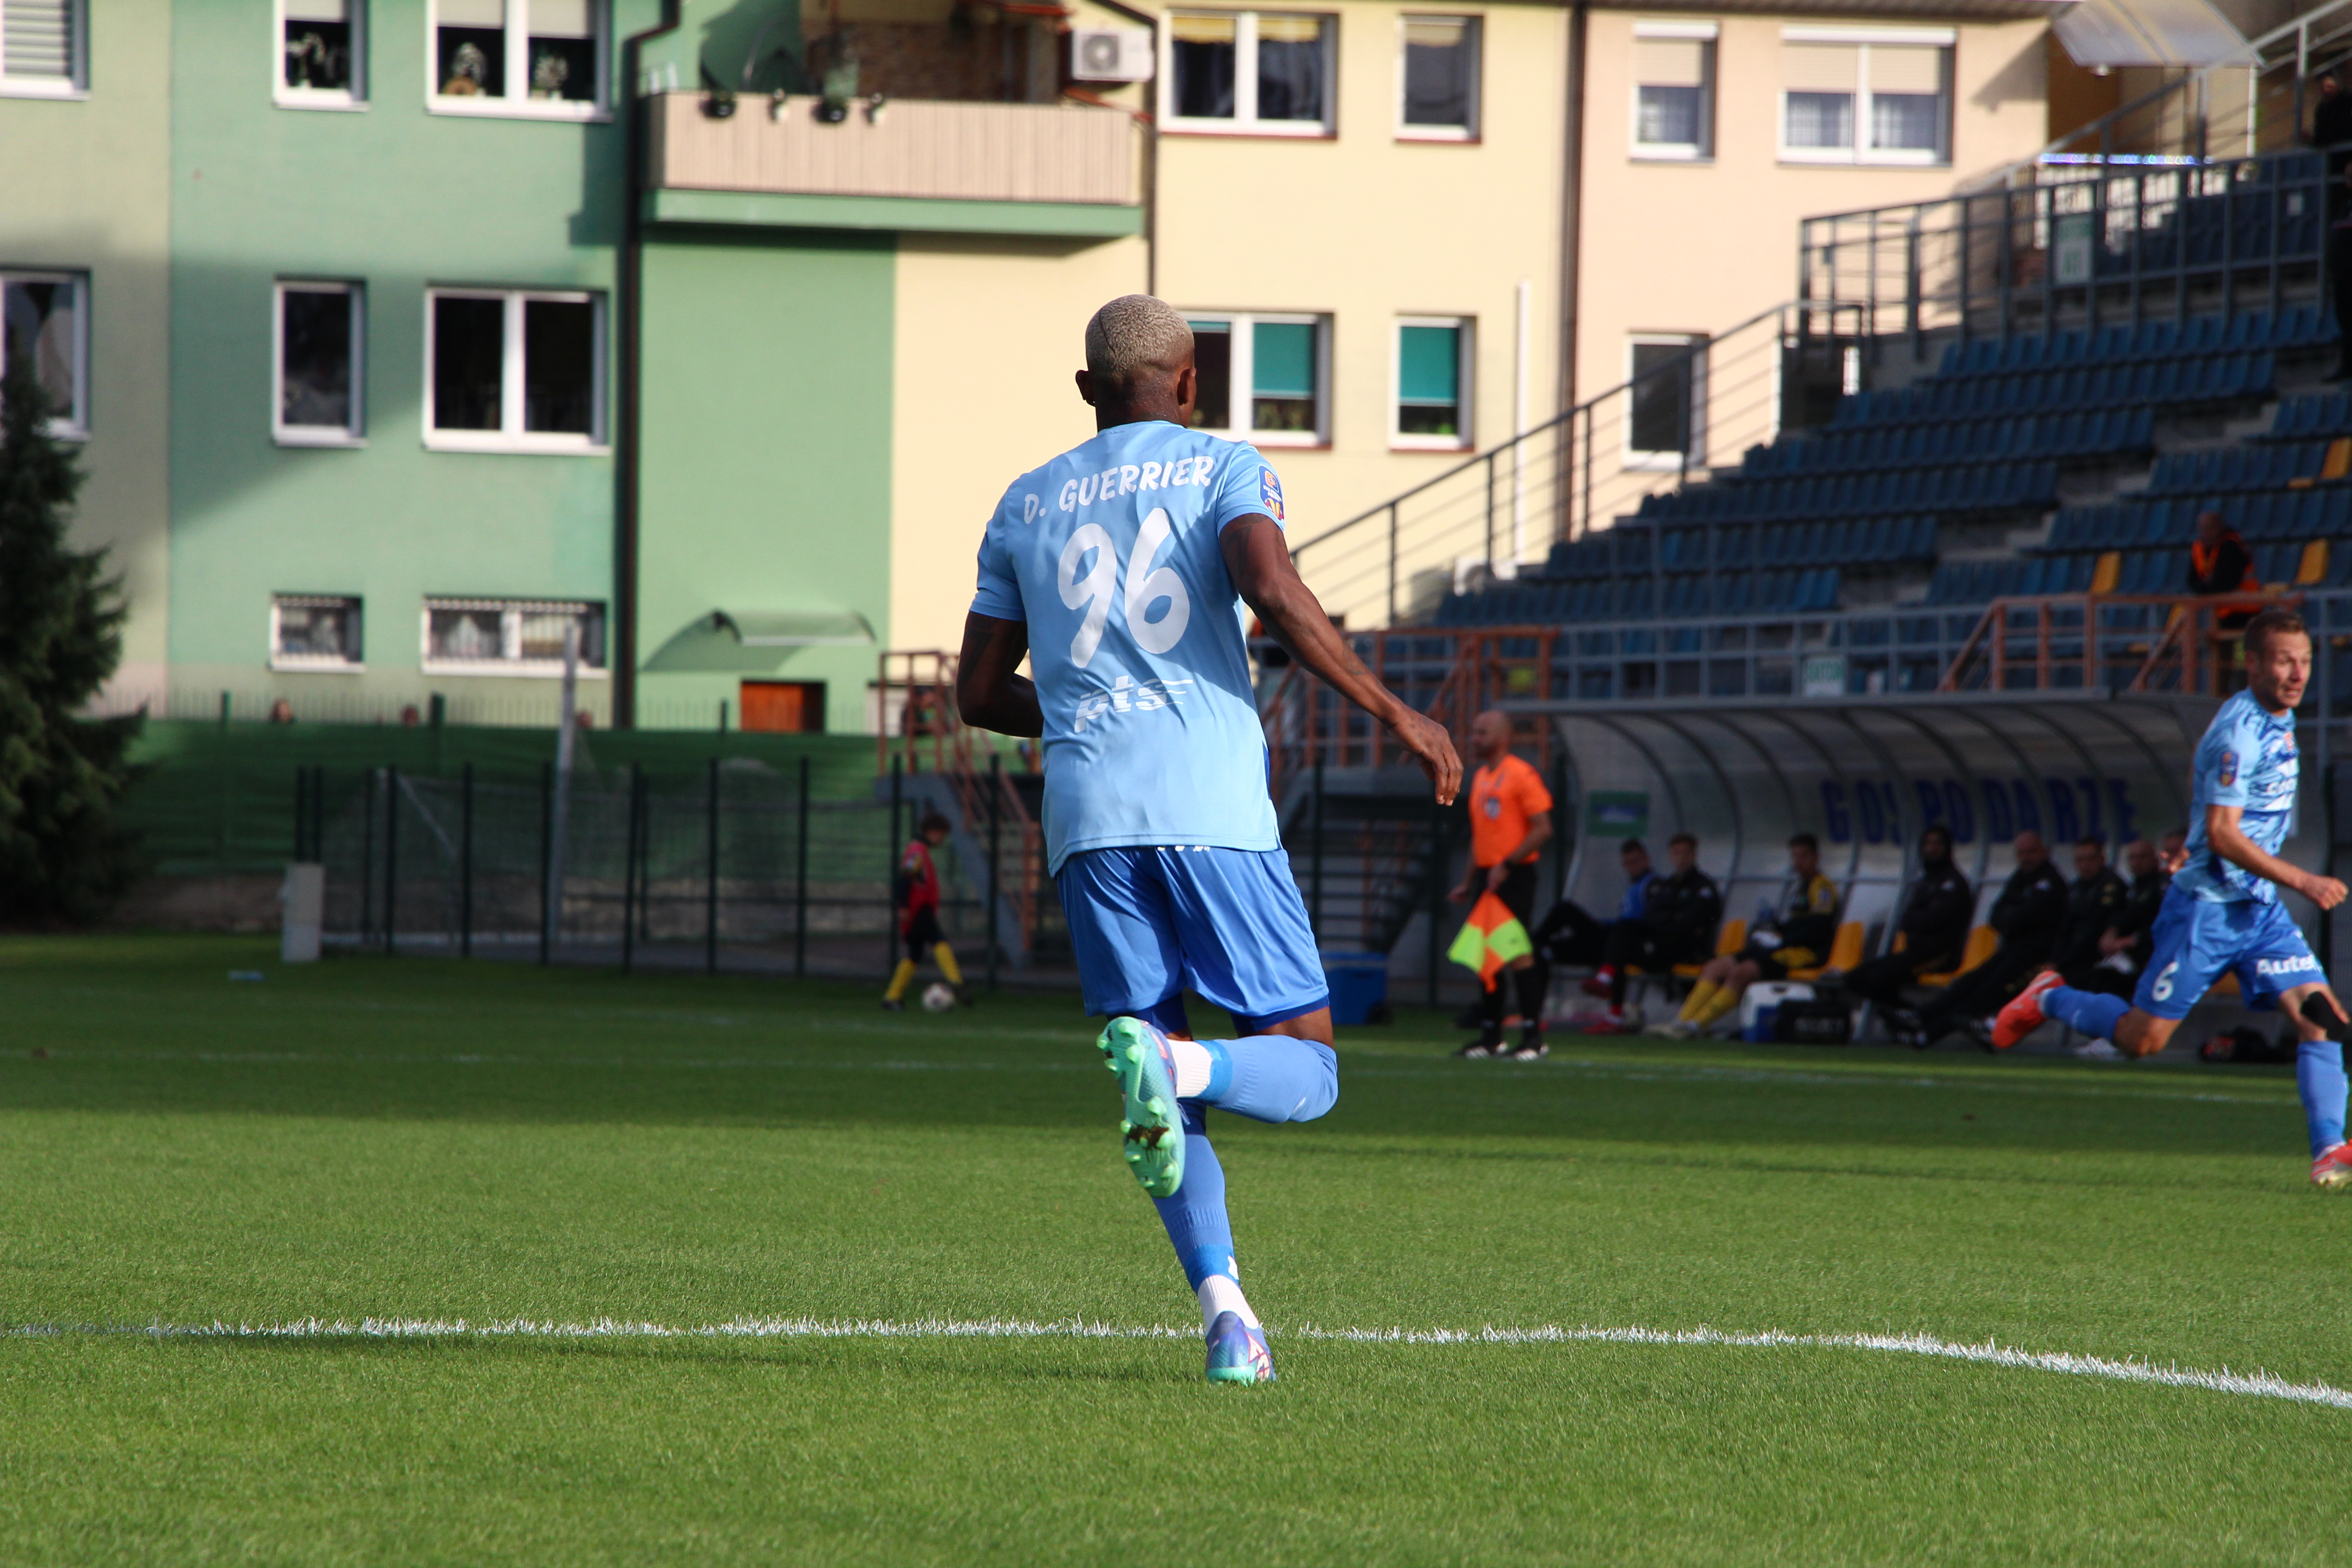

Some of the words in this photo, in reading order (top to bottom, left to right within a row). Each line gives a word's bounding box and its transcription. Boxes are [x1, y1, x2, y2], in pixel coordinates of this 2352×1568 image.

[1024, 493, 1046, 524] D.
[1059, 456, 1214, 513] GUERRIER
[1058, 507, 1191, 668] 96
[2151, 961, 2179, 1002] 6
